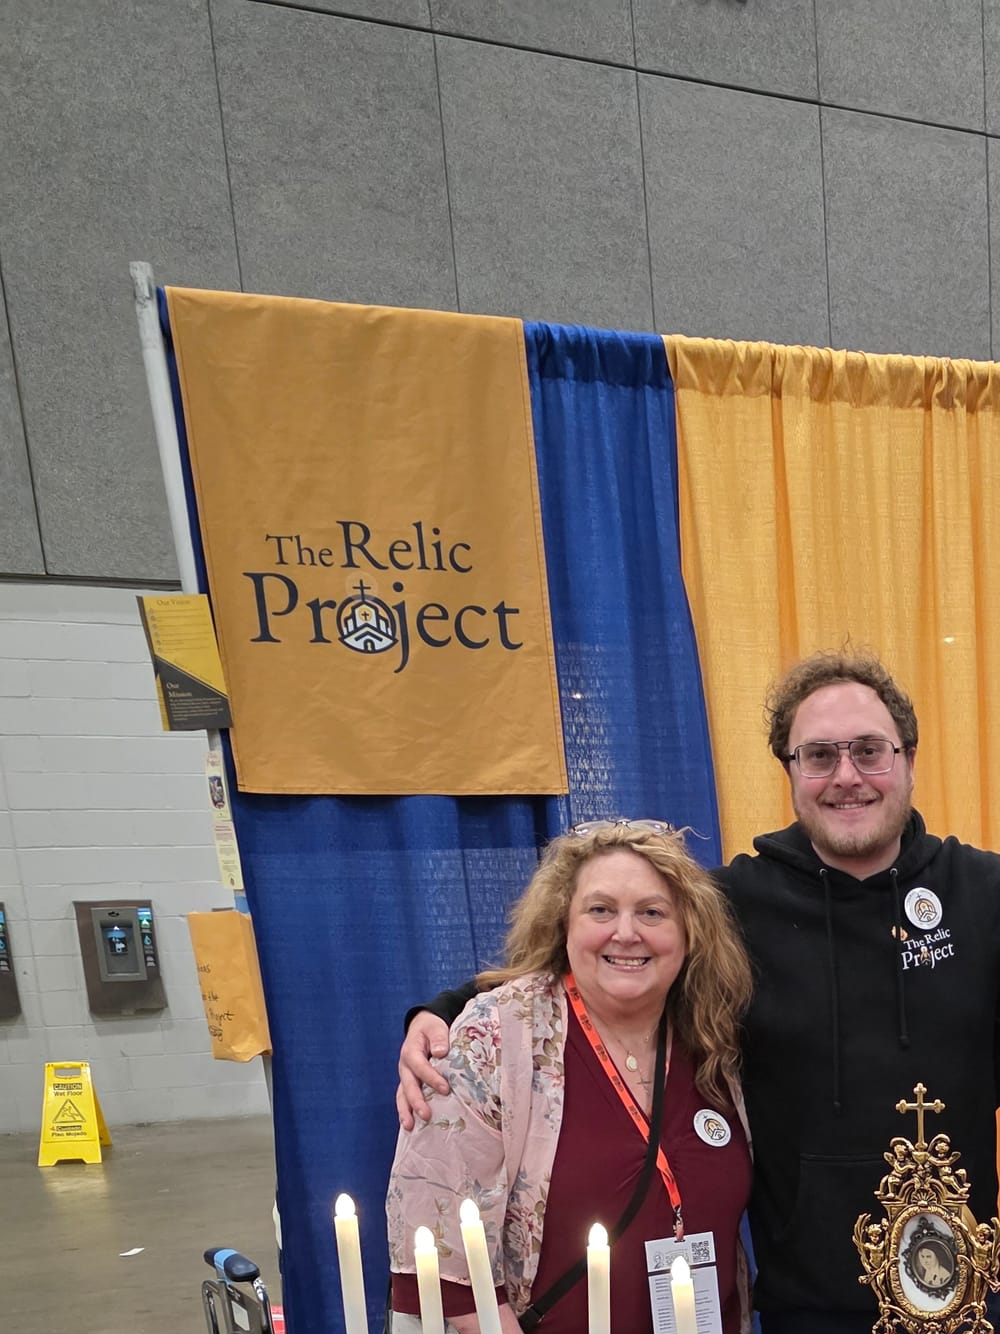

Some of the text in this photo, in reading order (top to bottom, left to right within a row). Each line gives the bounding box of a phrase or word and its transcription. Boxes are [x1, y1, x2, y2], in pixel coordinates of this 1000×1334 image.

[265, 520, 473, 574] The Relic
[243, 572, 523, 673] Project
[901, 943, 955, 970] Project
[904, 928, 951, 950] The Relic
